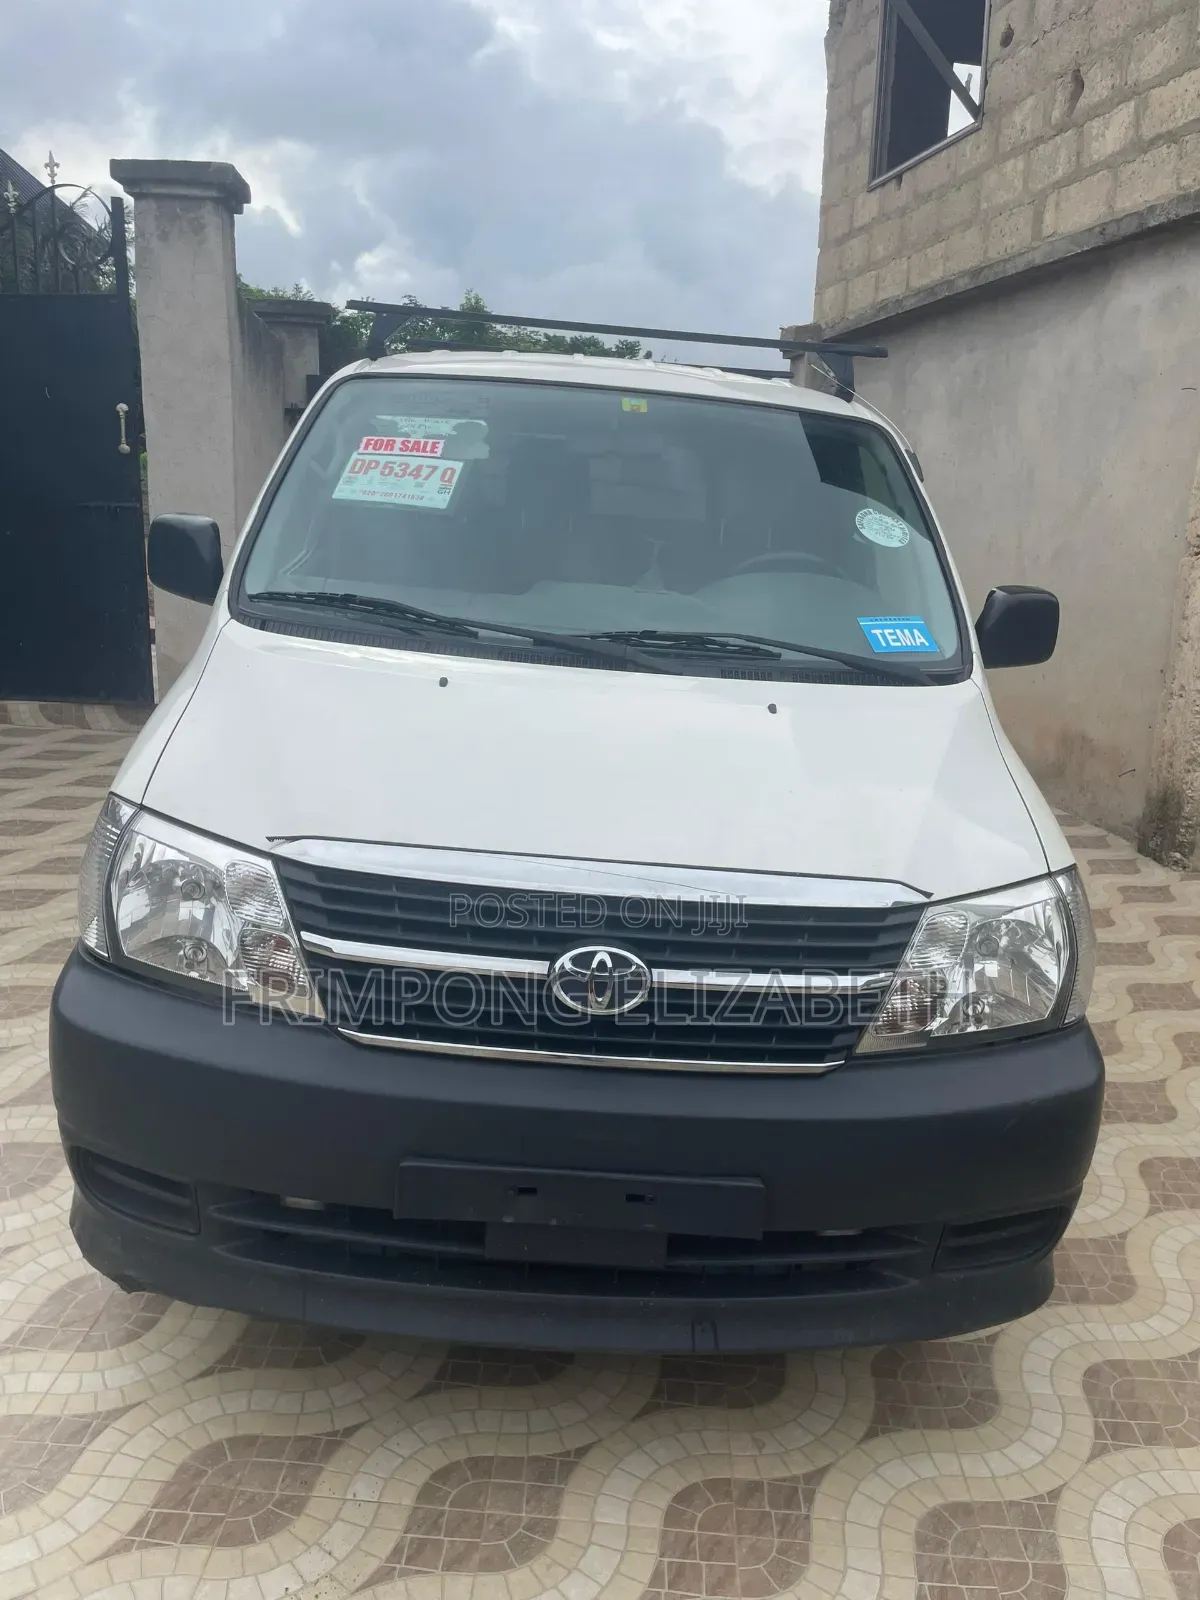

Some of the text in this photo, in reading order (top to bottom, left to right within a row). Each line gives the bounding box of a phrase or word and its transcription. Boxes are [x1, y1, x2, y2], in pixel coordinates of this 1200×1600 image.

[363, 438, 440, 454] FOR SALE
[348, 458, 380, 475] DP
[379, 462, 438, 481] 5347
[440, 467, 457, 484] Q
[871, 629, 930, 647] TEMA
